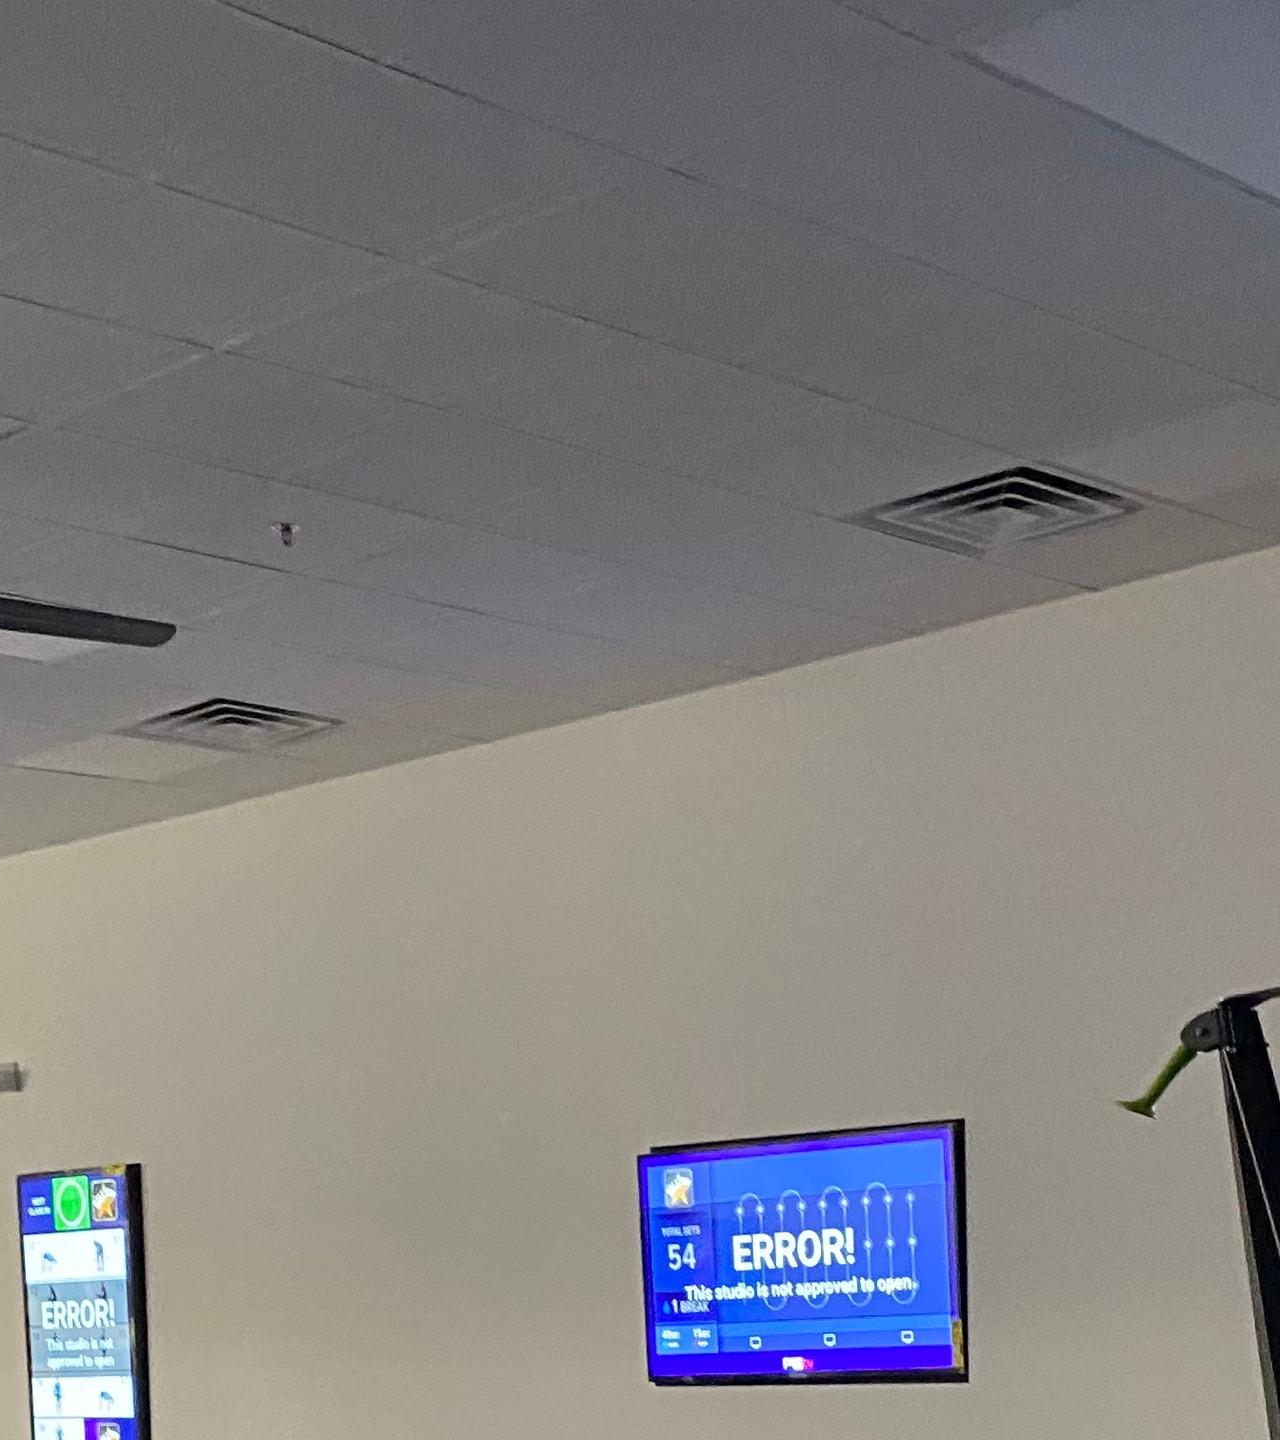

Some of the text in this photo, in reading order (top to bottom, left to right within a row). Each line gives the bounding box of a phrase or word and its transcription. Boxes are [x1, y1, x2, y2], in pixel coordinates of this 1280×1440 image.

[667, 1243, 696, 1271] 54
[732, 1227, 856, 1272] ERROR!
[685, 1284, 713, 1301] This
[715, 1282, 754, 1301] studio
[756, 1281, 770, 1298] is
[771, 1281, 794, 1298] not
[795, 1275, 858, 1300] approved
[860, 1276, 875, 1292] to
[41, 1298, 115, 1330] ERROR!
[671, 1298, 710, 1314] 1 BREAK
